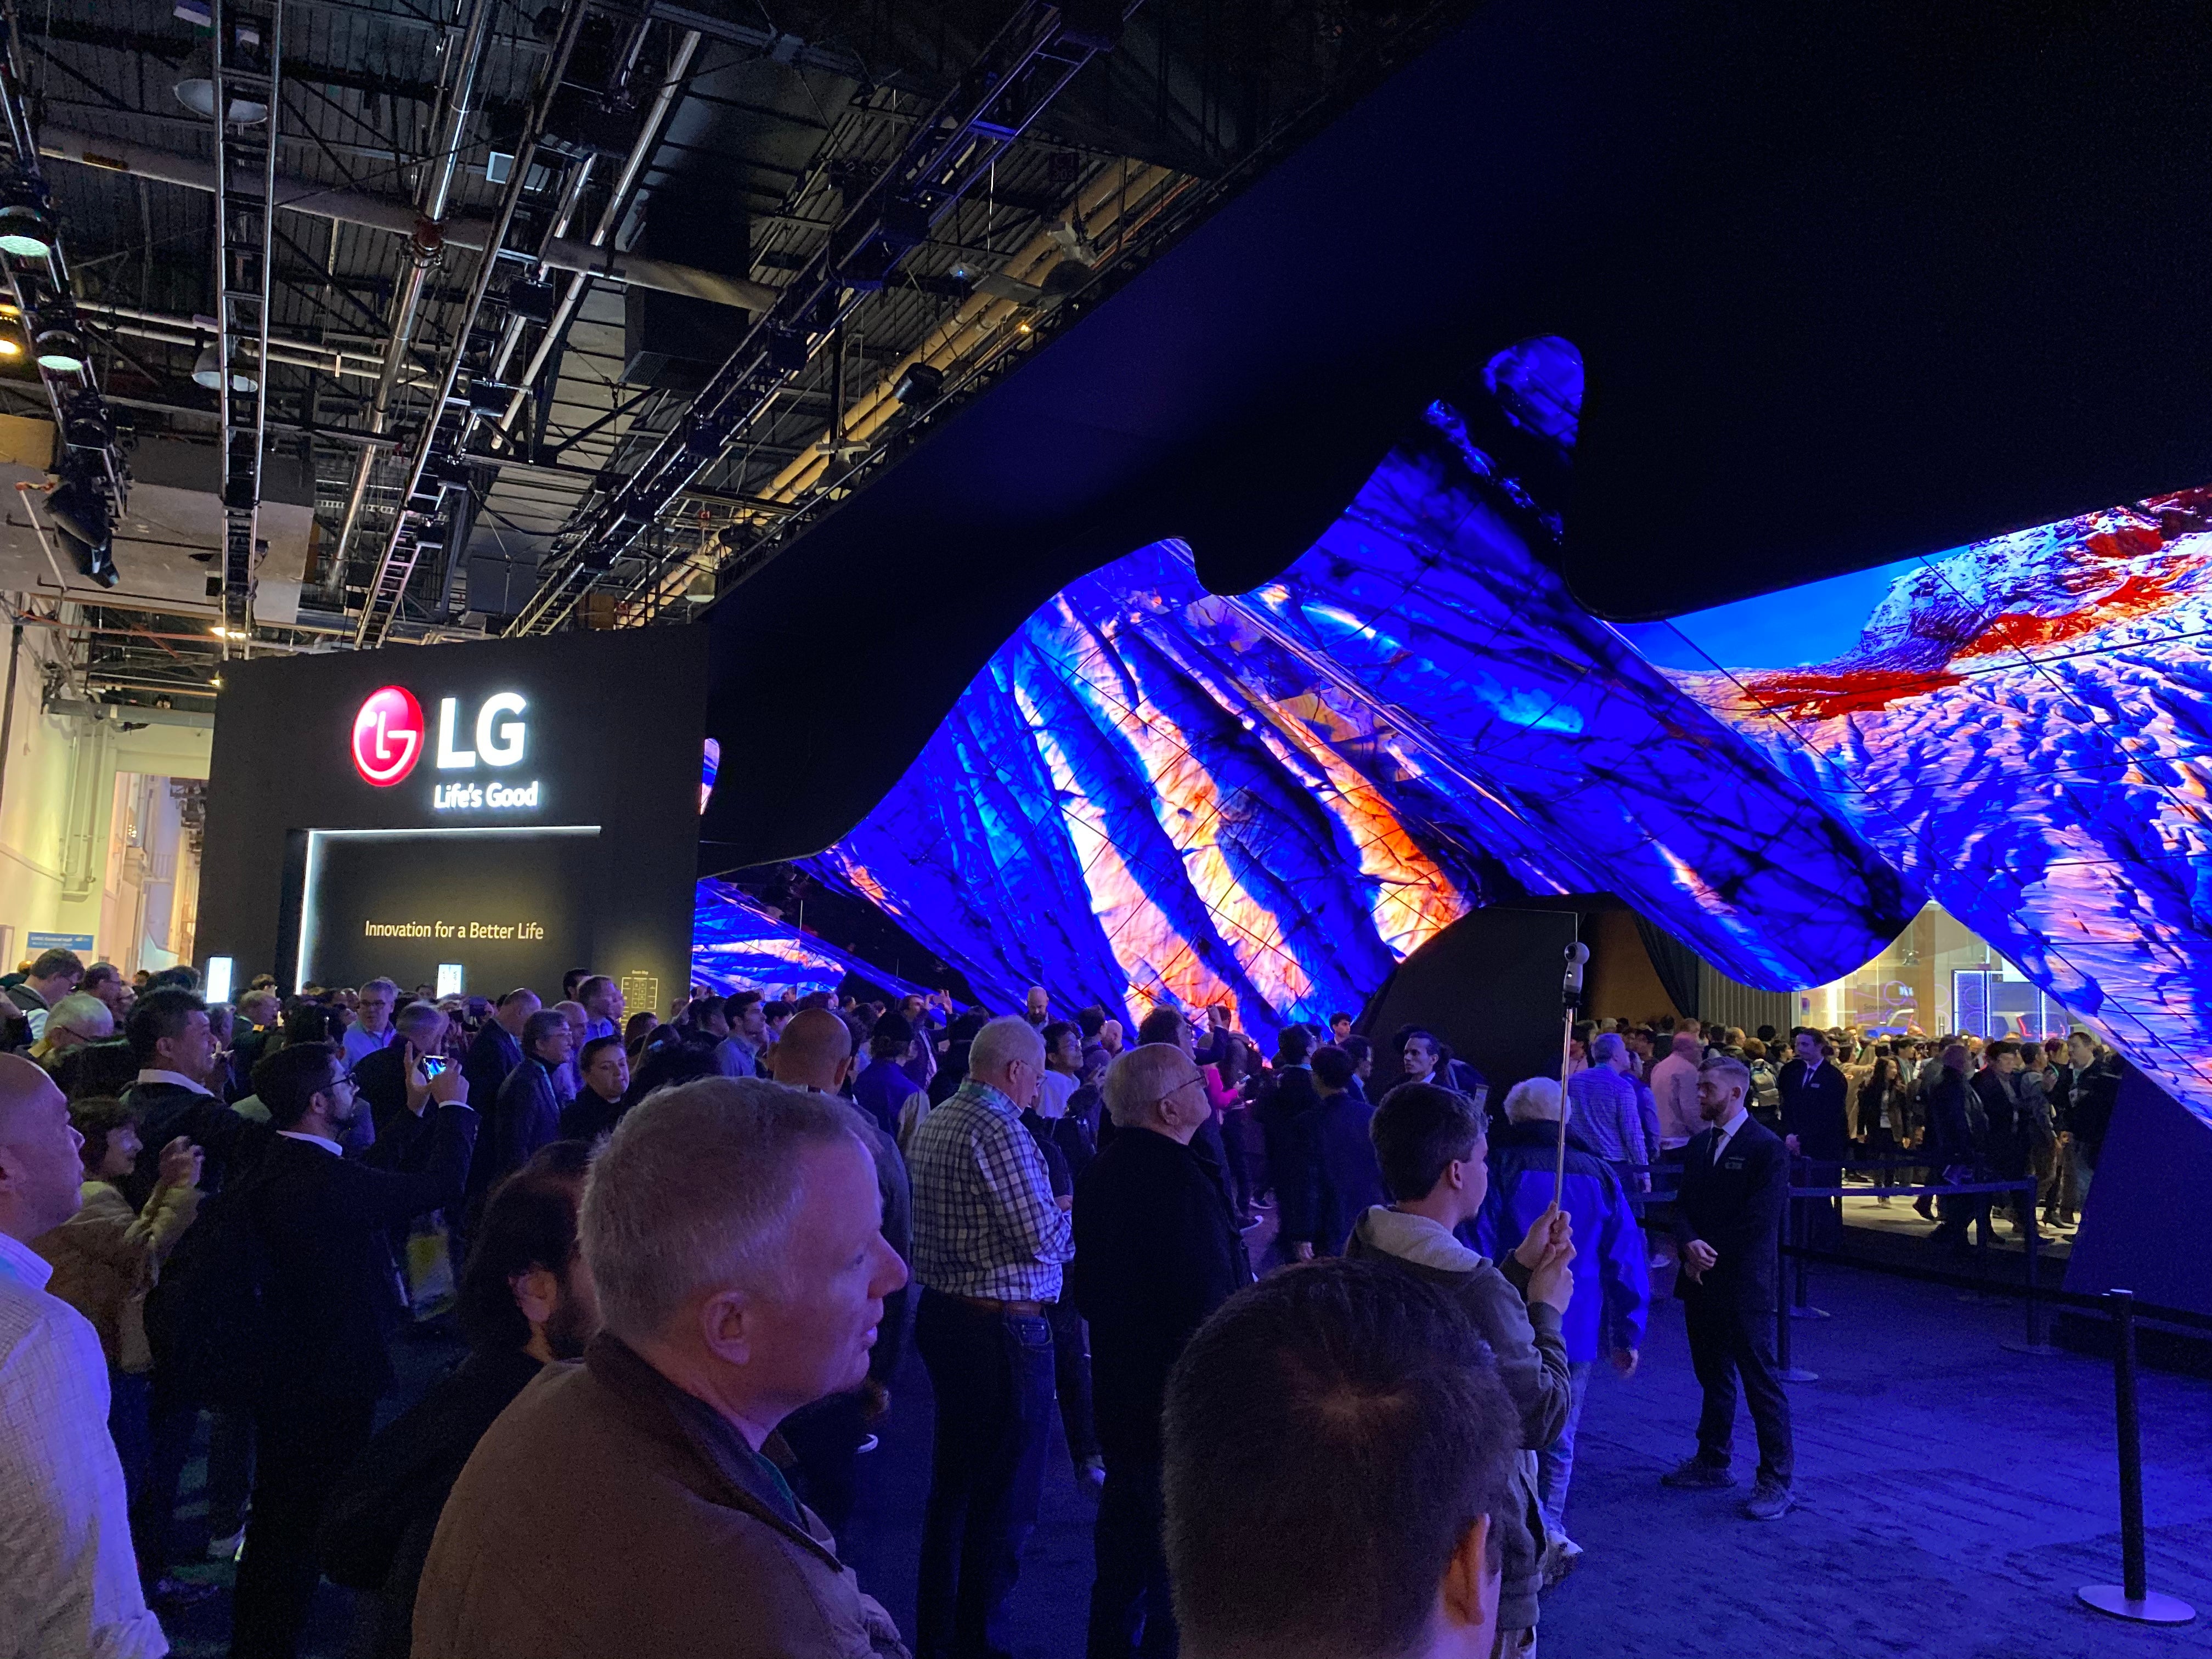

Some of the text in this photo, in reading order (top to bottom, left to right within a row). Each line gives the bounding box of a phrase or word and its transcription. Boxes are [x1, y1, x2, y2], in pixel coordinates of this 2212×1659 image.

[437, 692, 527, 769] LG
[434, 781, 539, 809] Life's Good
[365, 920, 544, 940] Innovation for a Better Life
